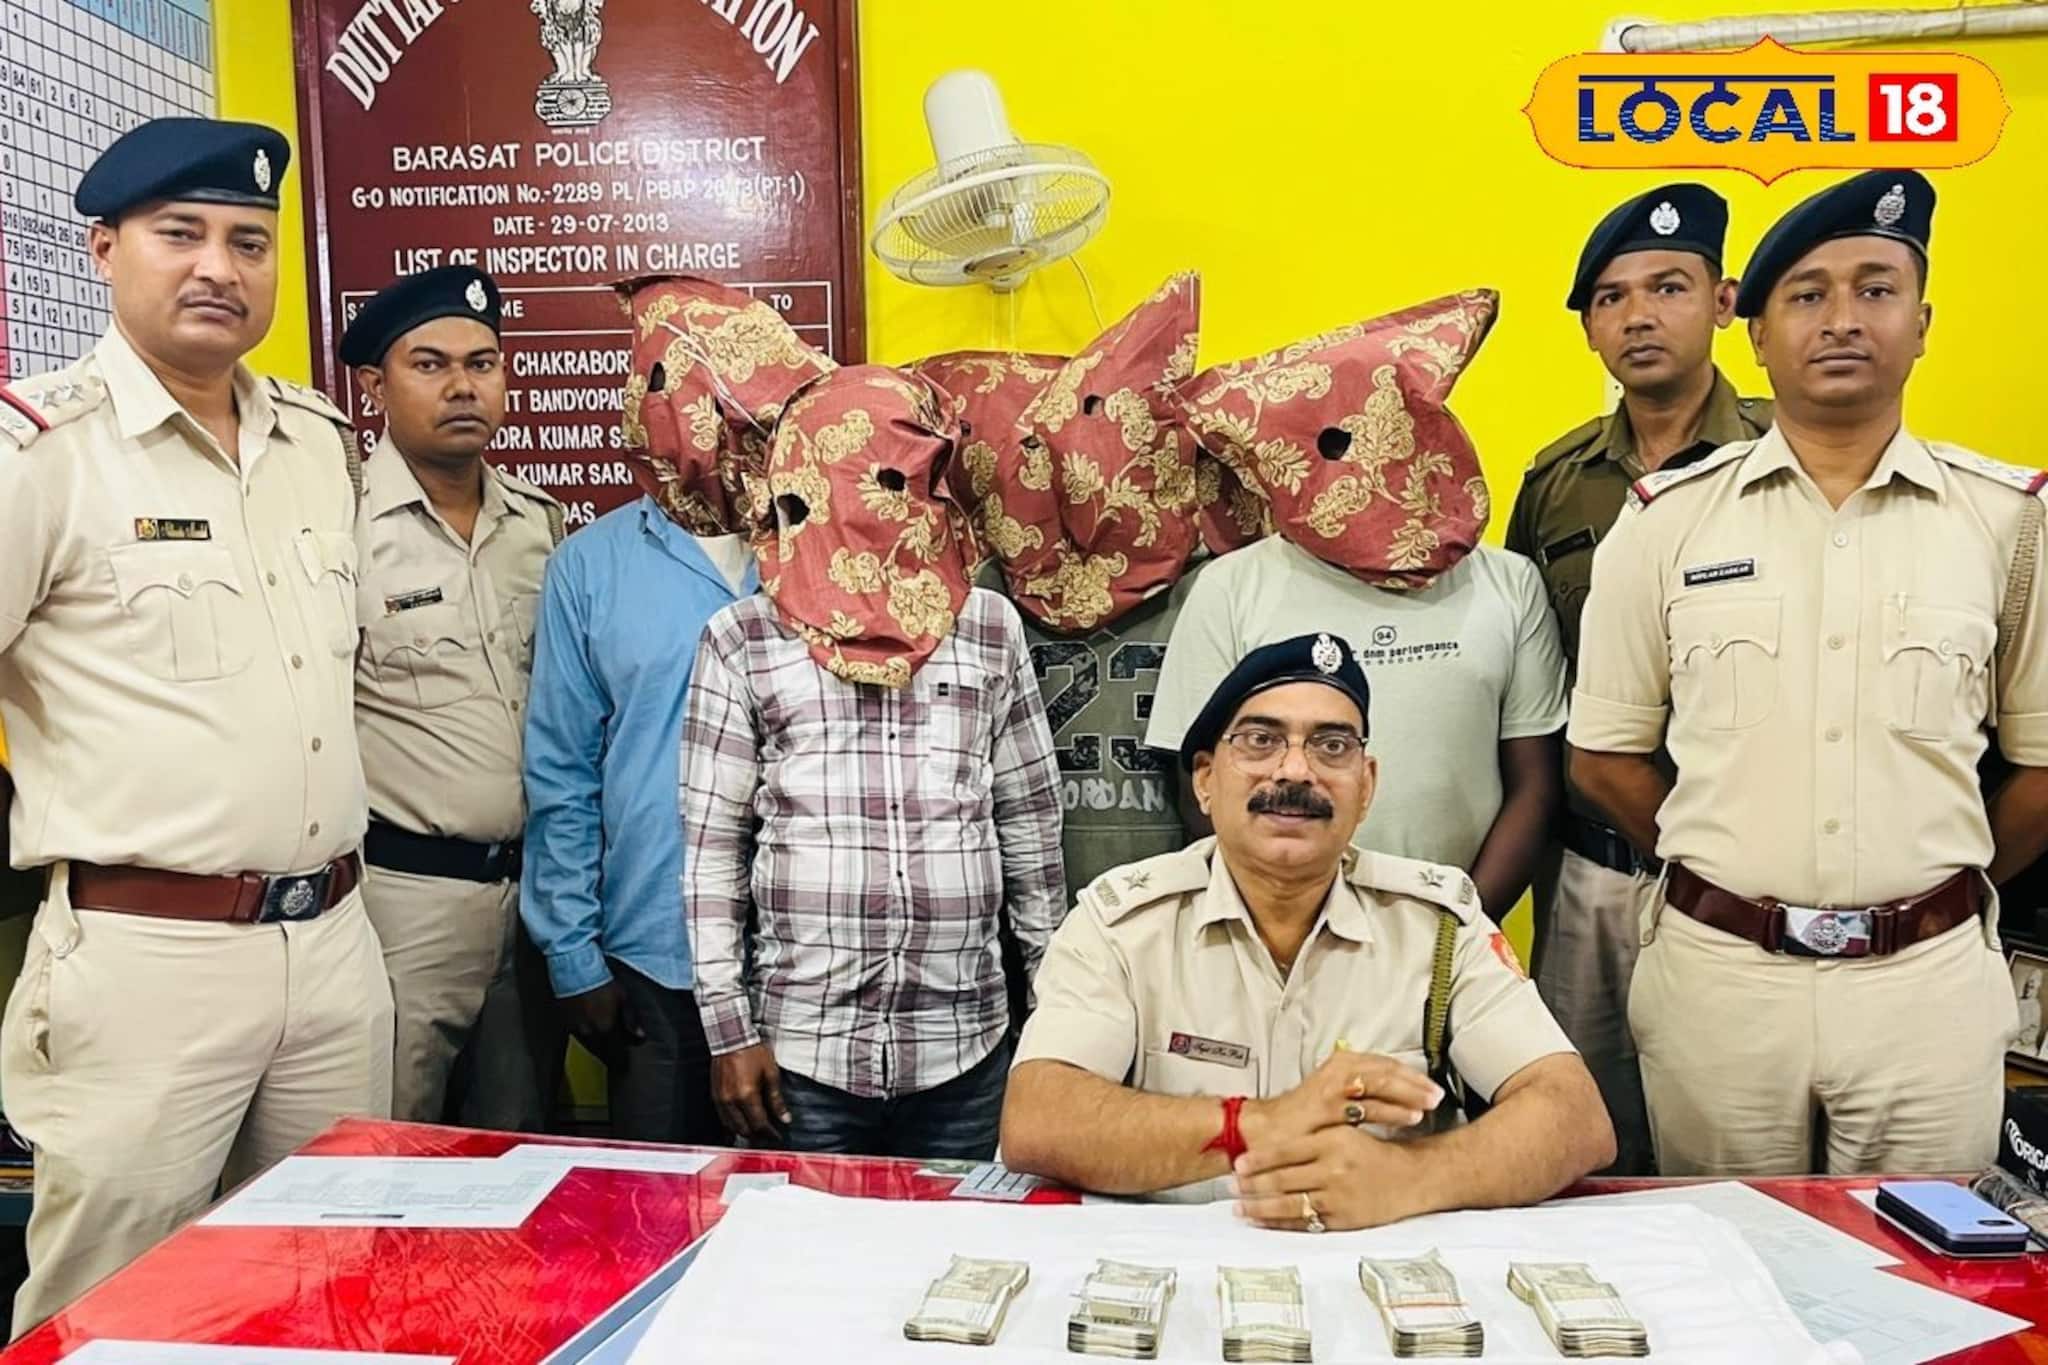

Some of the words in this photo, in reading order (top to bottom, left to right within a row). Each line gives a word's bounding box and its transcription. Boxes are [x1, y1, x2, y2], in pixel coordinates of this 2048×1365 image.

[325, 0, 458, 111] DUTTA
[393, 143, 520, 171] BARASAT
[536, 140, 630, 167] POLICE
[642, 136, 766, 163] DISTRICT
[390, 184, 509, 207] NOTIFICATION
[494, 216, 535, 235] DATE
[395, 249, 442, 276] LIST
[486, 245, 608, 275] INSPECTOR
[616, 244, 639, 271] IN
[646, 243, 741, 270] CHARGE
[770, 294, 792, 310] TO
[539, 425, 604, 450] KUMAR
[517, 463, 584, 486] KUMAR
